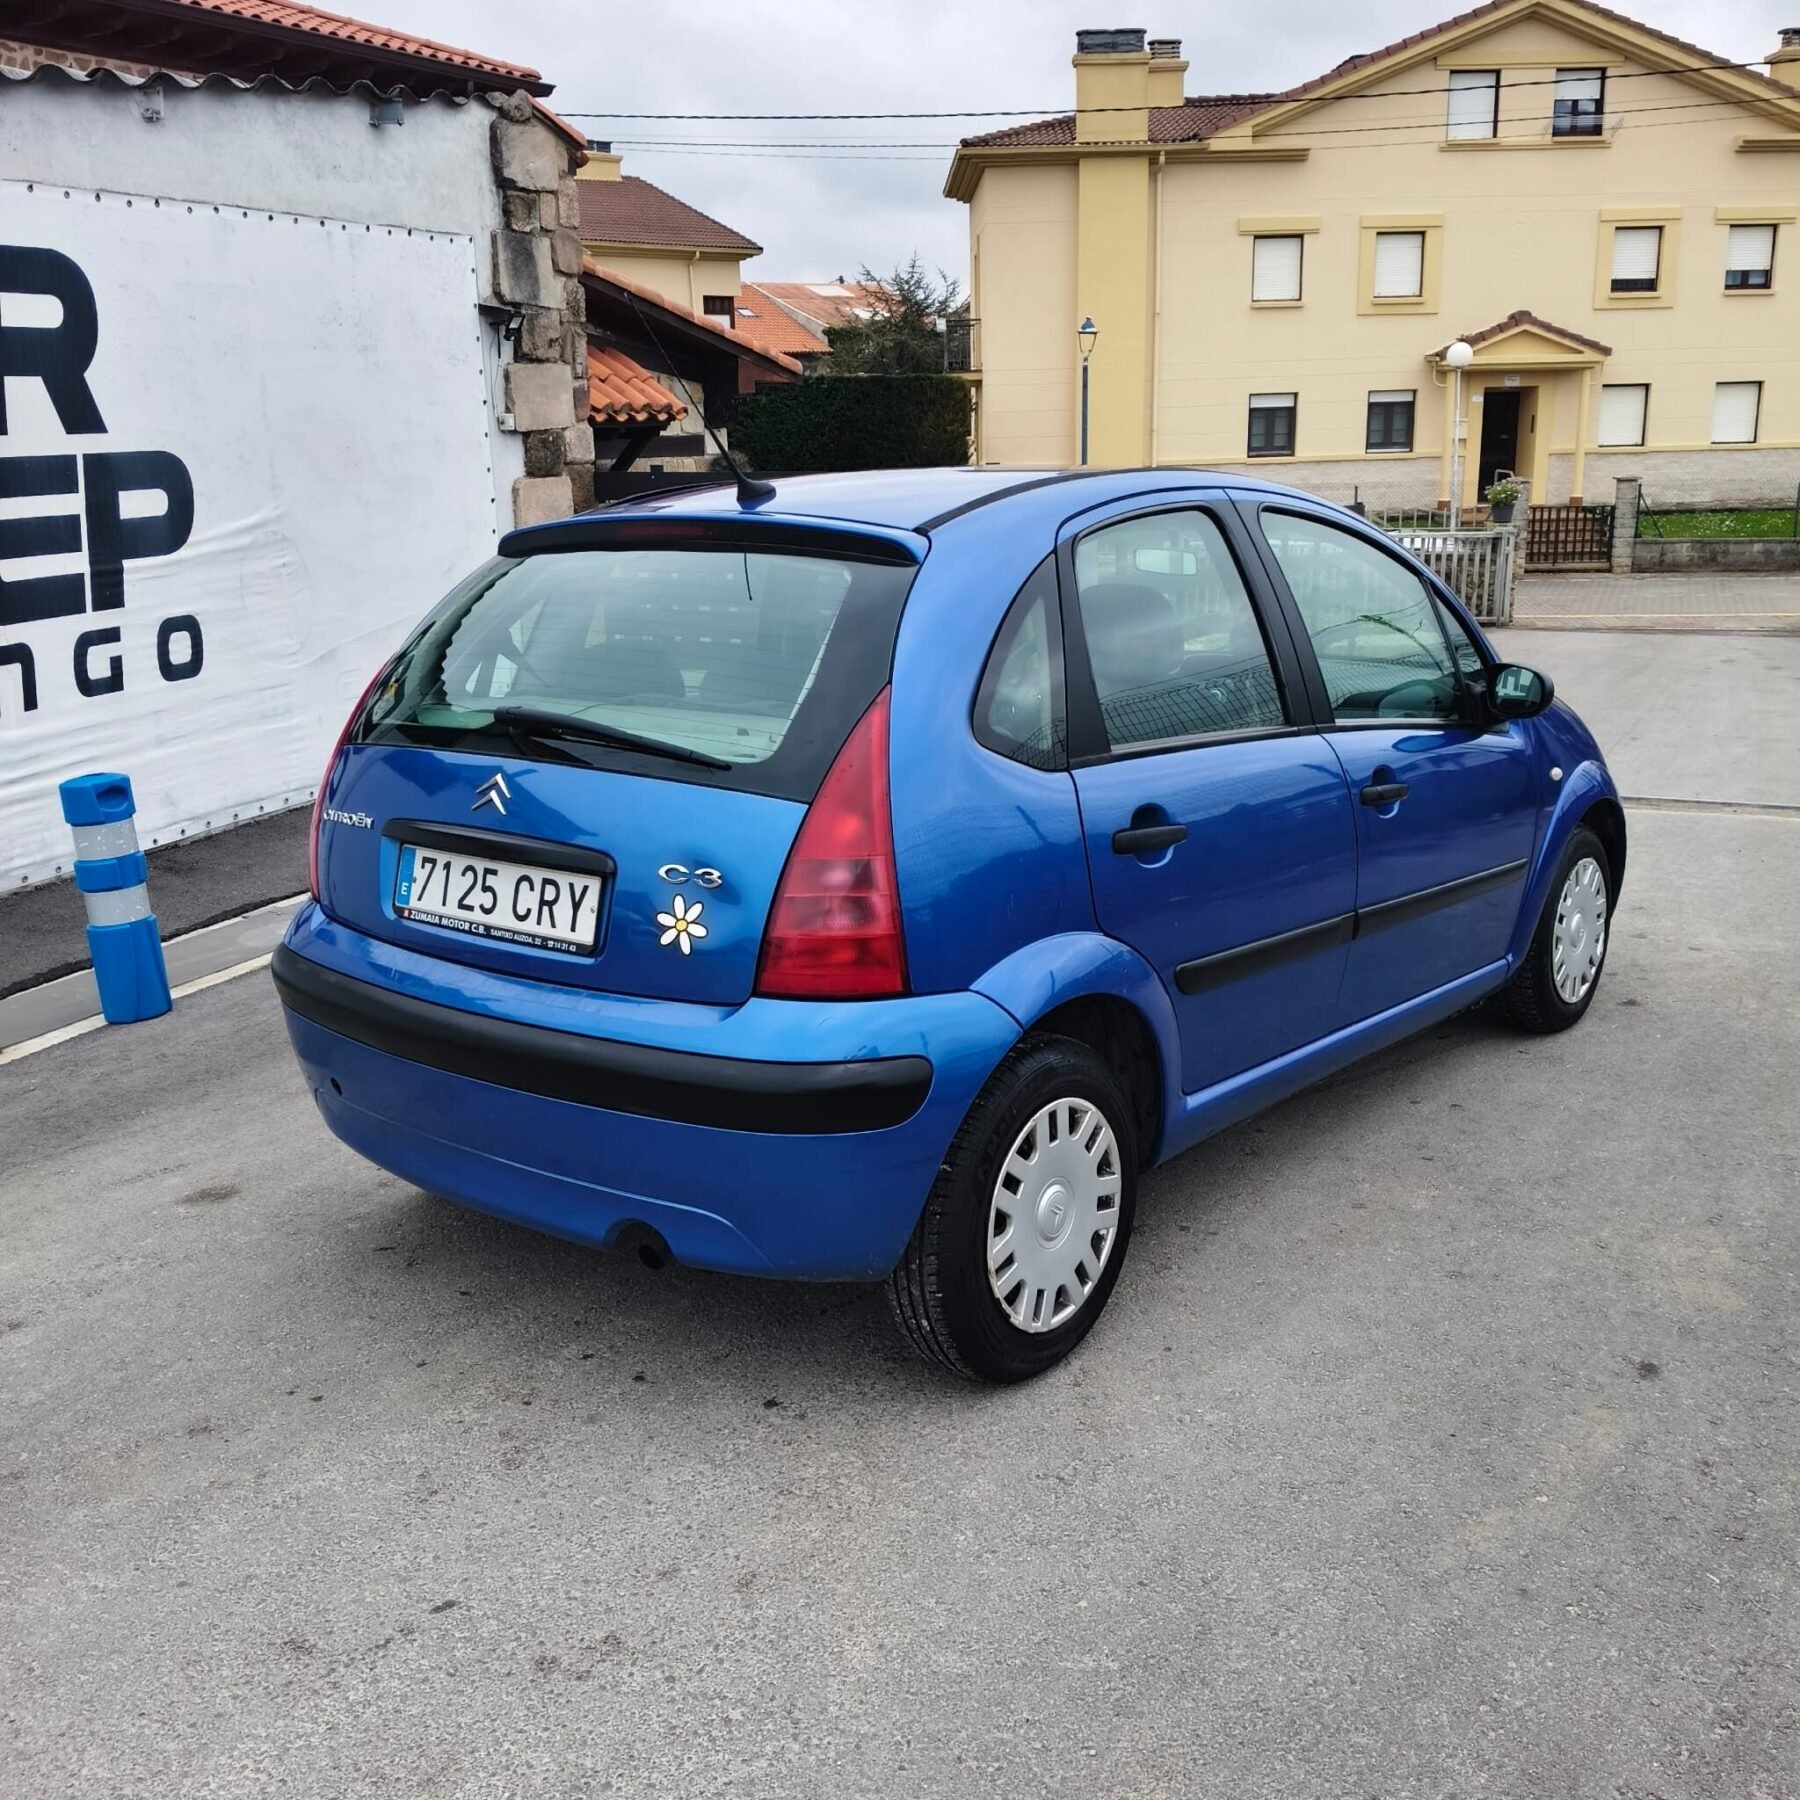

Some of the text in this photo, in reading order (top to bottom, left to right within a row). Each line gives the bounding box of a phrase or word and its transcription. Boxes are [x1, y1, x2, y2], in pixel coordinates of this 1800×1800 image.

[657, 864, 722, 889] C3
[401, 882, 409, 896] E
[416, 856, 590, 933] 7125 CRY
[410, 910, 440, 925] ZUMAIA
[441, 917, 470, 931] MOTOR
